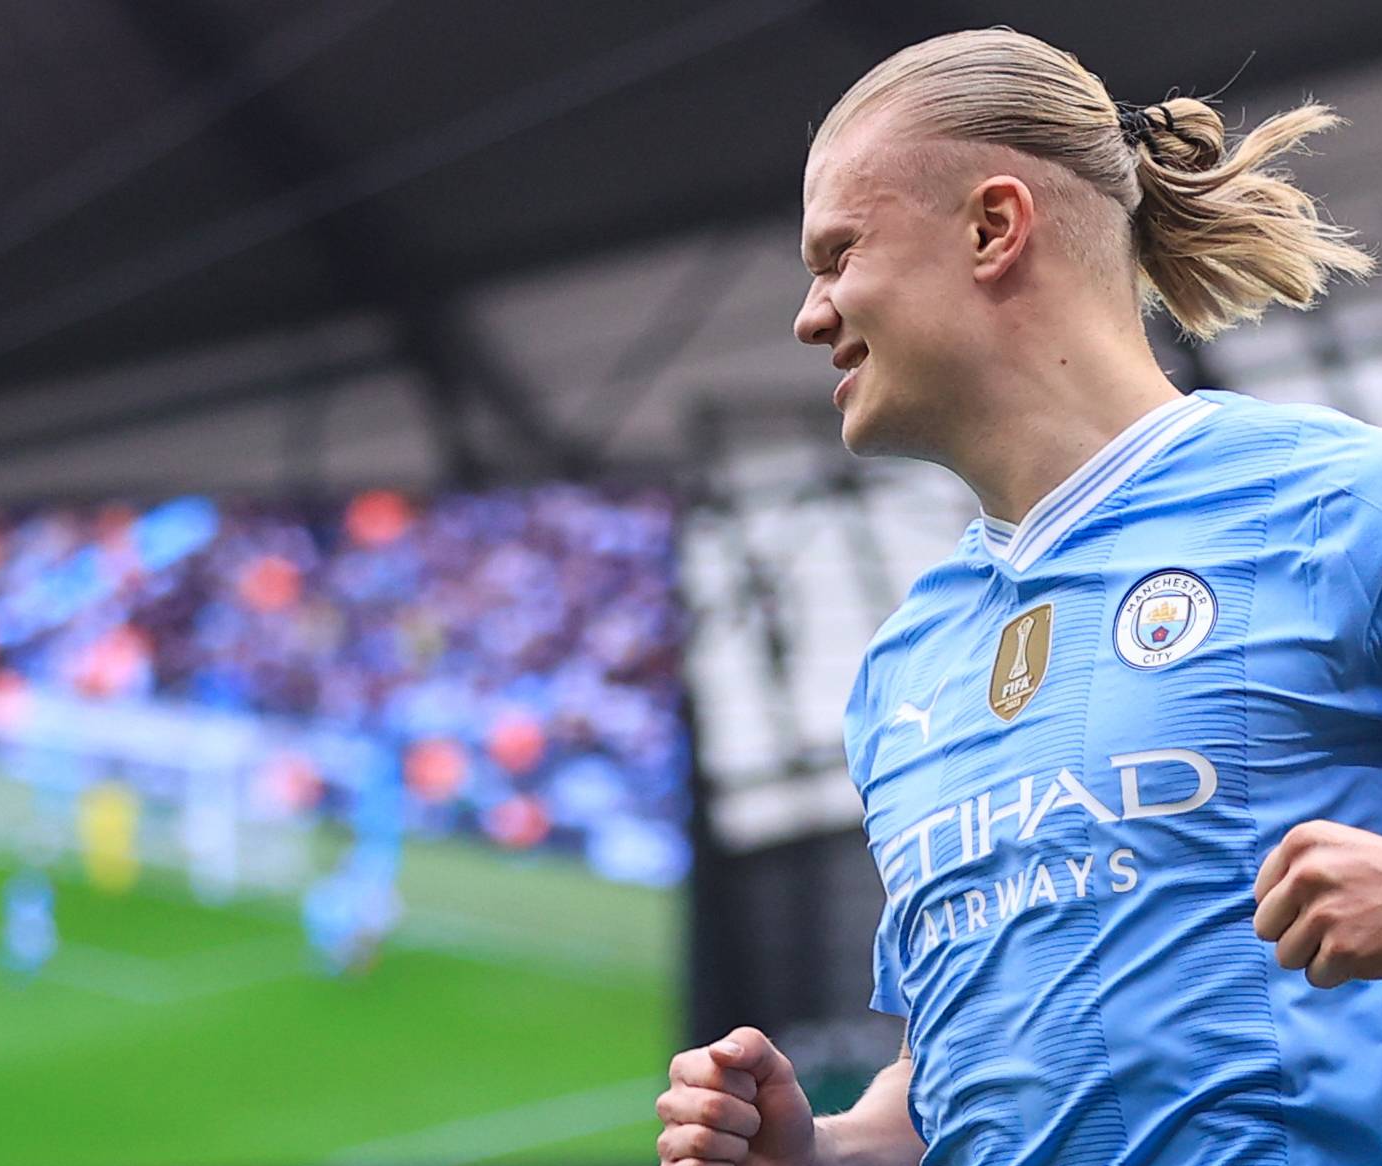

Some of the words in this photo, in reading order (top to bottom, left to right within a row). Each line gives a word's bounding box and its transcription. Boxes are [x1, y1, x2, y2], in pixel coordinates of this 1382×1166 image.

[1127, 578, 1208, 613] MANCHESTER
[1142, 652, 1172, 664] CITY
[1002, 676, 1030, 699] FIFA
[882, 748, 1218, 905] ETIHAD
[921, 848, 1138, 949] AIRWAYS
